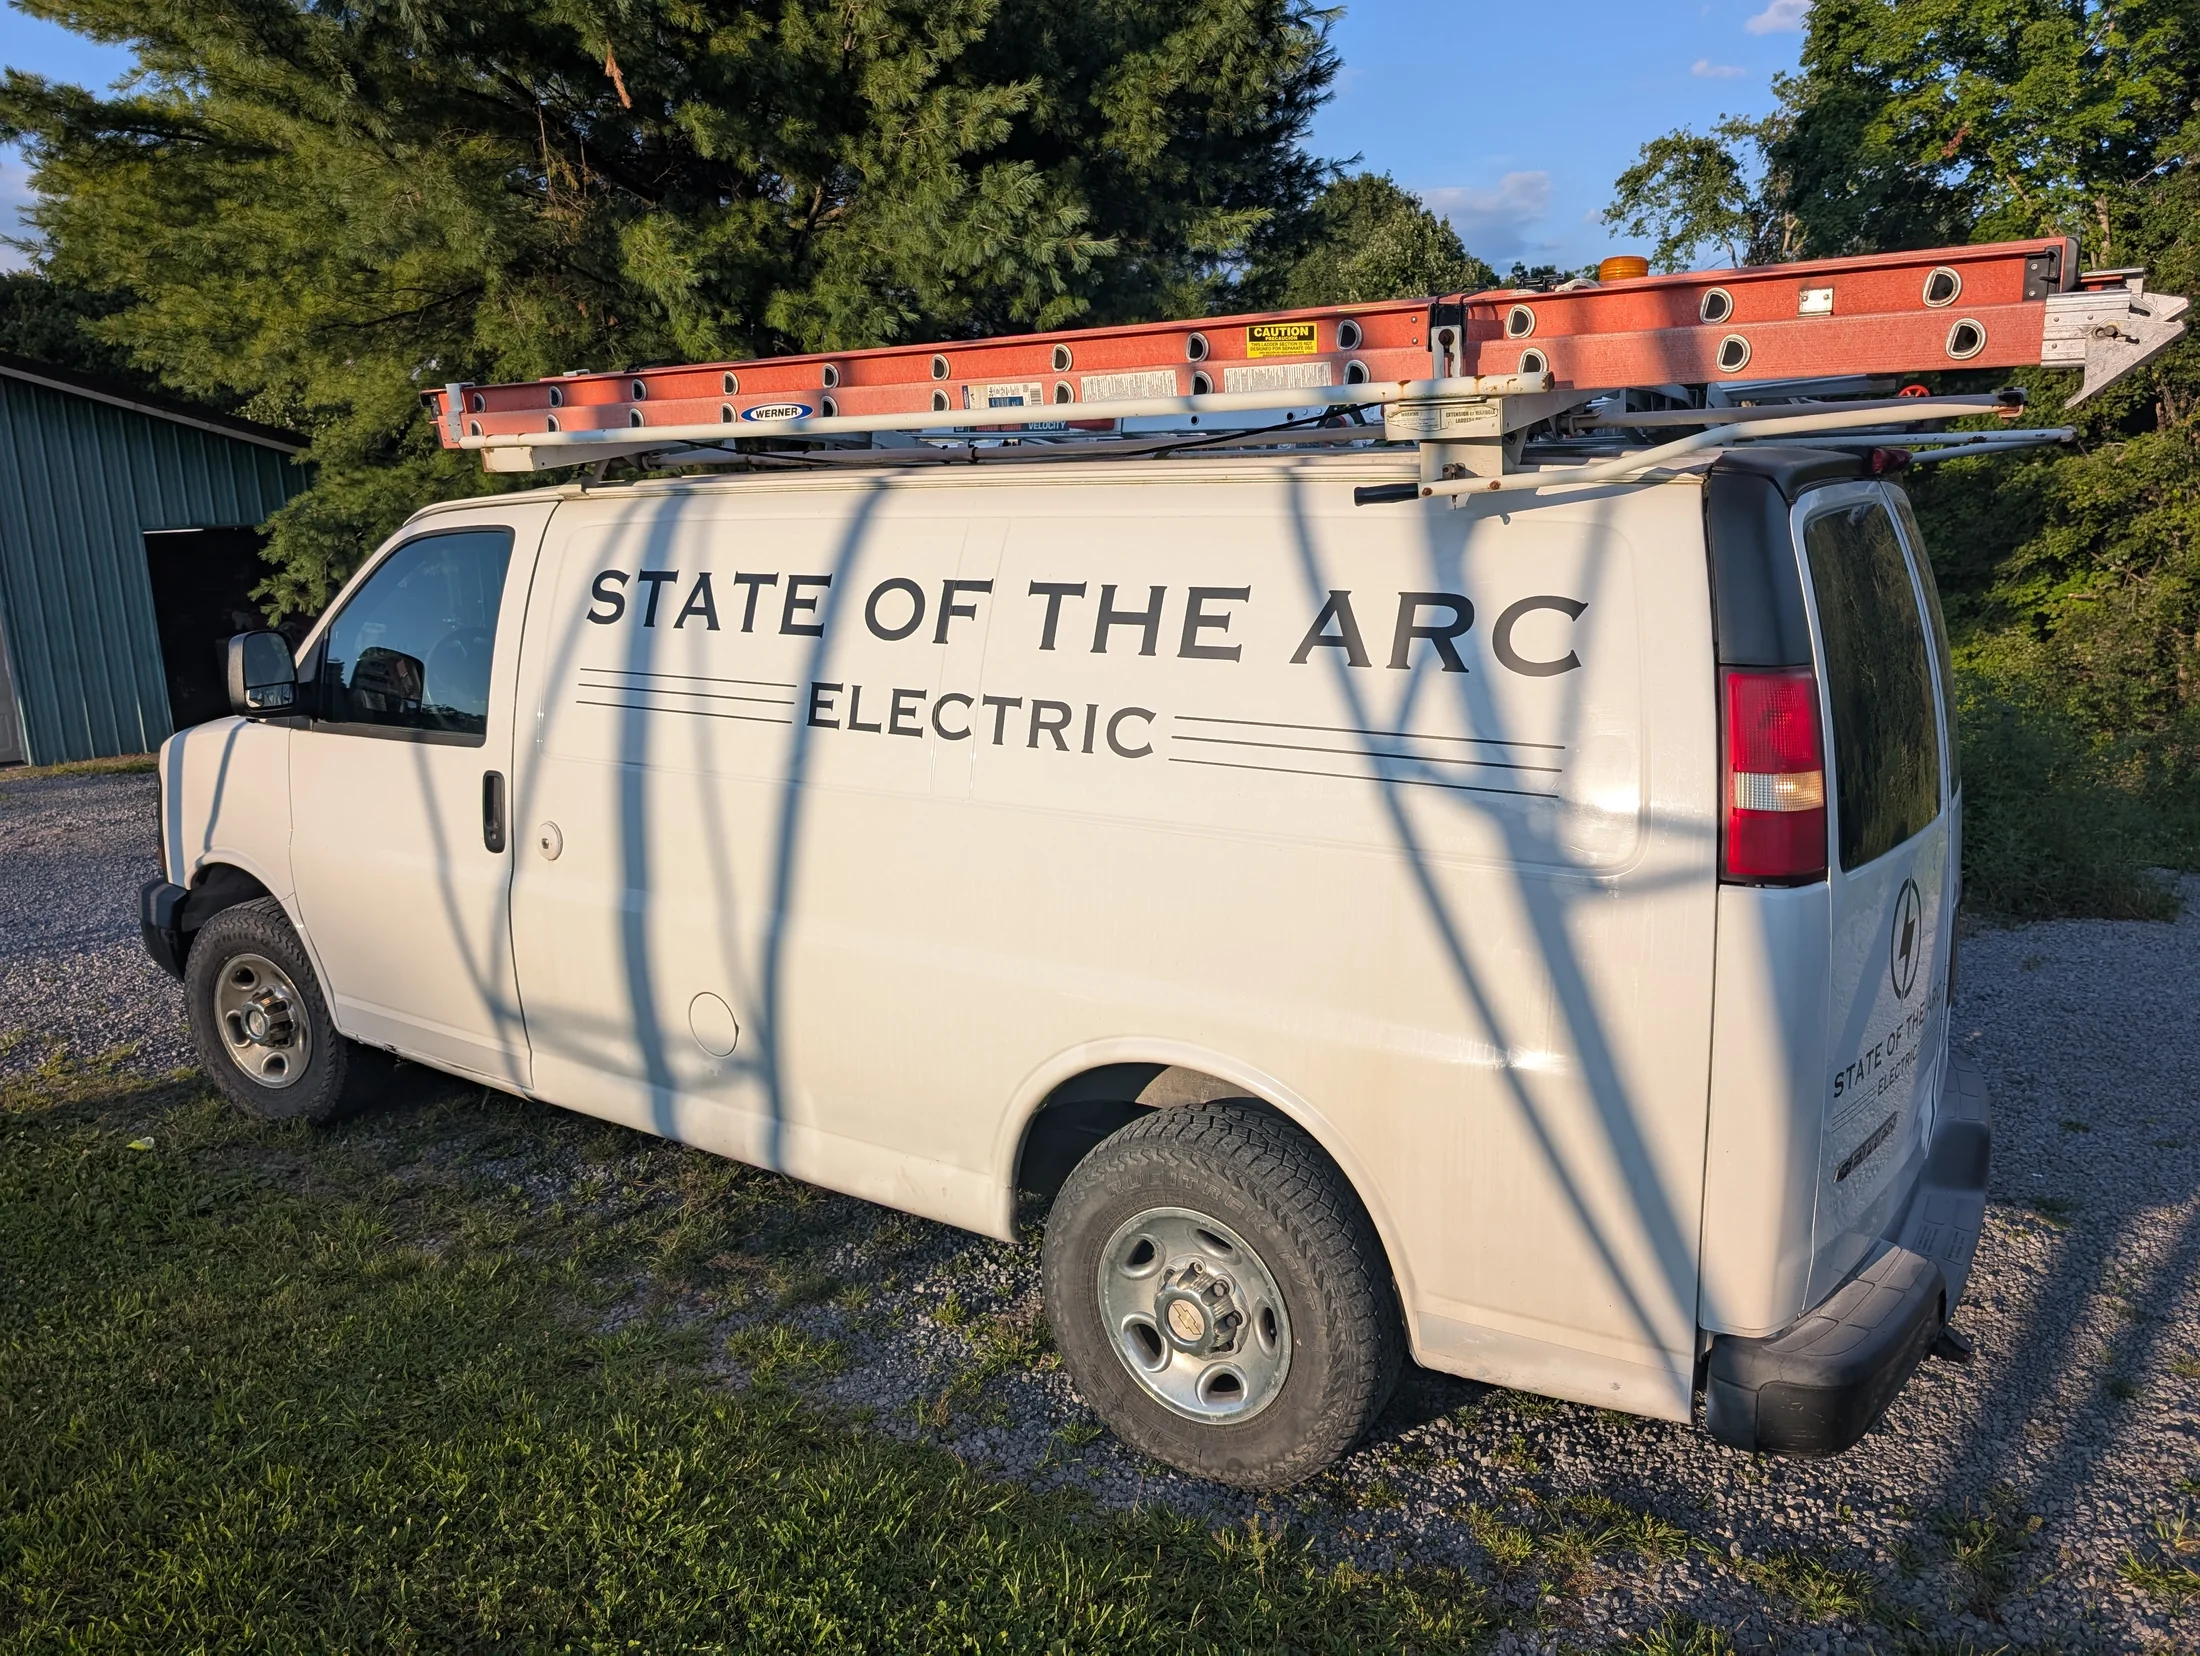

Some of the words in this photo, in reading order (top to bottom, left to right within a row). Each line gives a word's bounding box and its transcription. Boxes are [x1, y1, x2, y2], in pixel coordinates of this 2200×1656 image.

[1253, 326, 1309, 337] CAUTION
[755, 407, 798, 419] WERNER
[1028, 420, 1066, 430] VELOCITY
[585, 569, 833, 639] STATE
[864, 577, 994, 645] OF
[1027, 578, 1252, 664] THE
[1288, 589, 1589, 677] ARC
[806, 681, 1157, 758] ELECTRIC
[1833, 1041, 1883, 1099] STATE
[1886, 1023, 1904, 1057] OF
[1906, 1001, 1925, 1039] THE
[1927, 979, 1942, 1013] ARC
[1877, 1044, 1918, 1097] ELECTRIC
